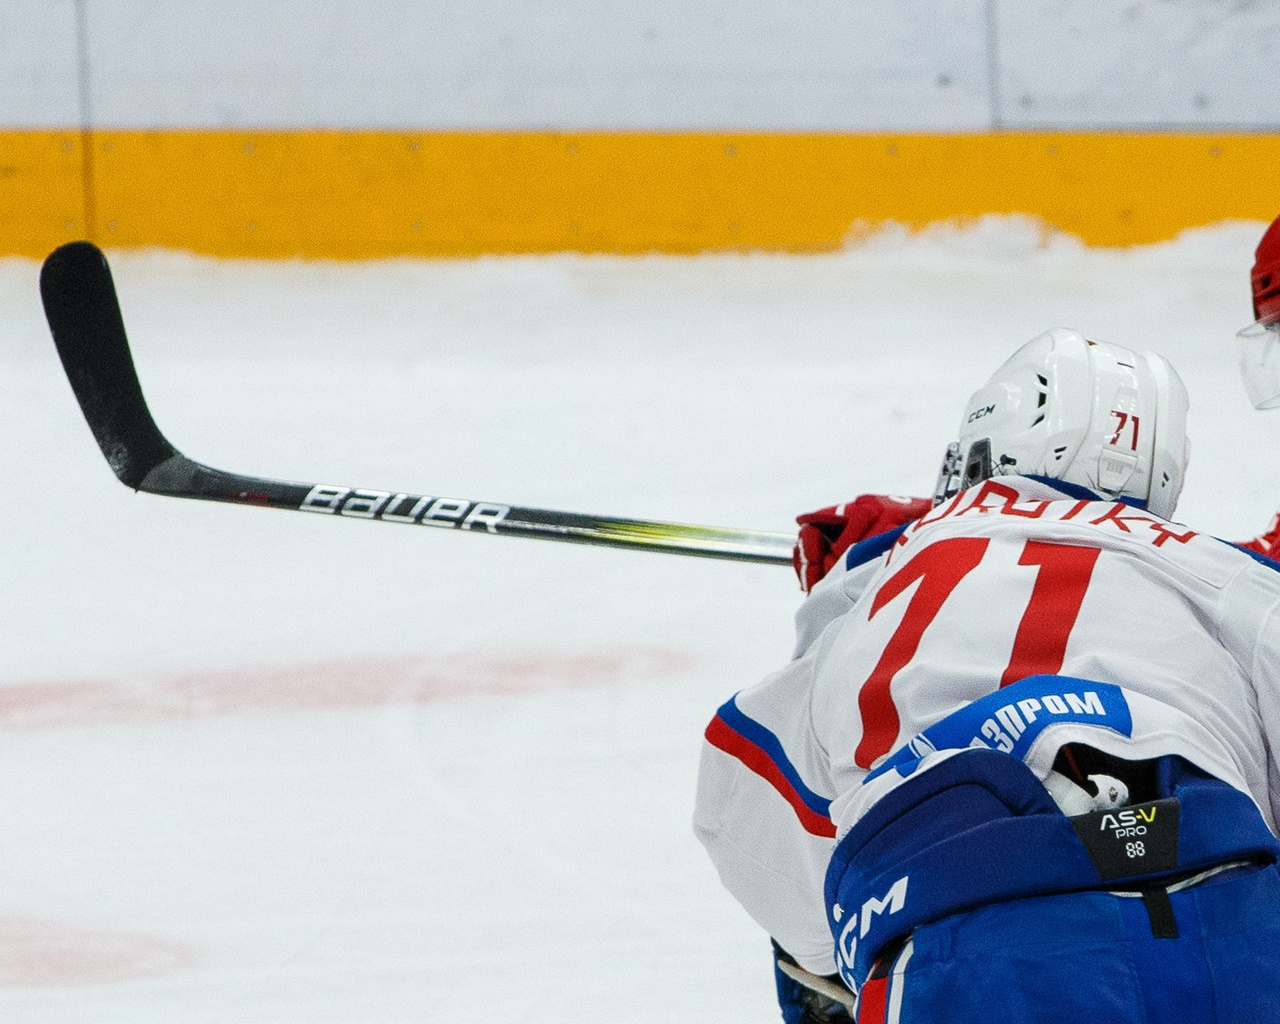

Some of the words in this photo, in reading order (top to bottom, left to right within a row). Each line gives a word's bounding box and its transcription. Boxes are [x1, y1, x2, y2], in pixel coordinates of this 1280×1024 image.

[968, 404, 996, 423] CCM
[1109, 410, 1140, 451] 71
[855, 537, 1102, 770] 71
[1100, 806, 1156, 831] AS-V
[1115, 825, 1147, 839] PRO
[1125, 841, 1145, 858] 88
